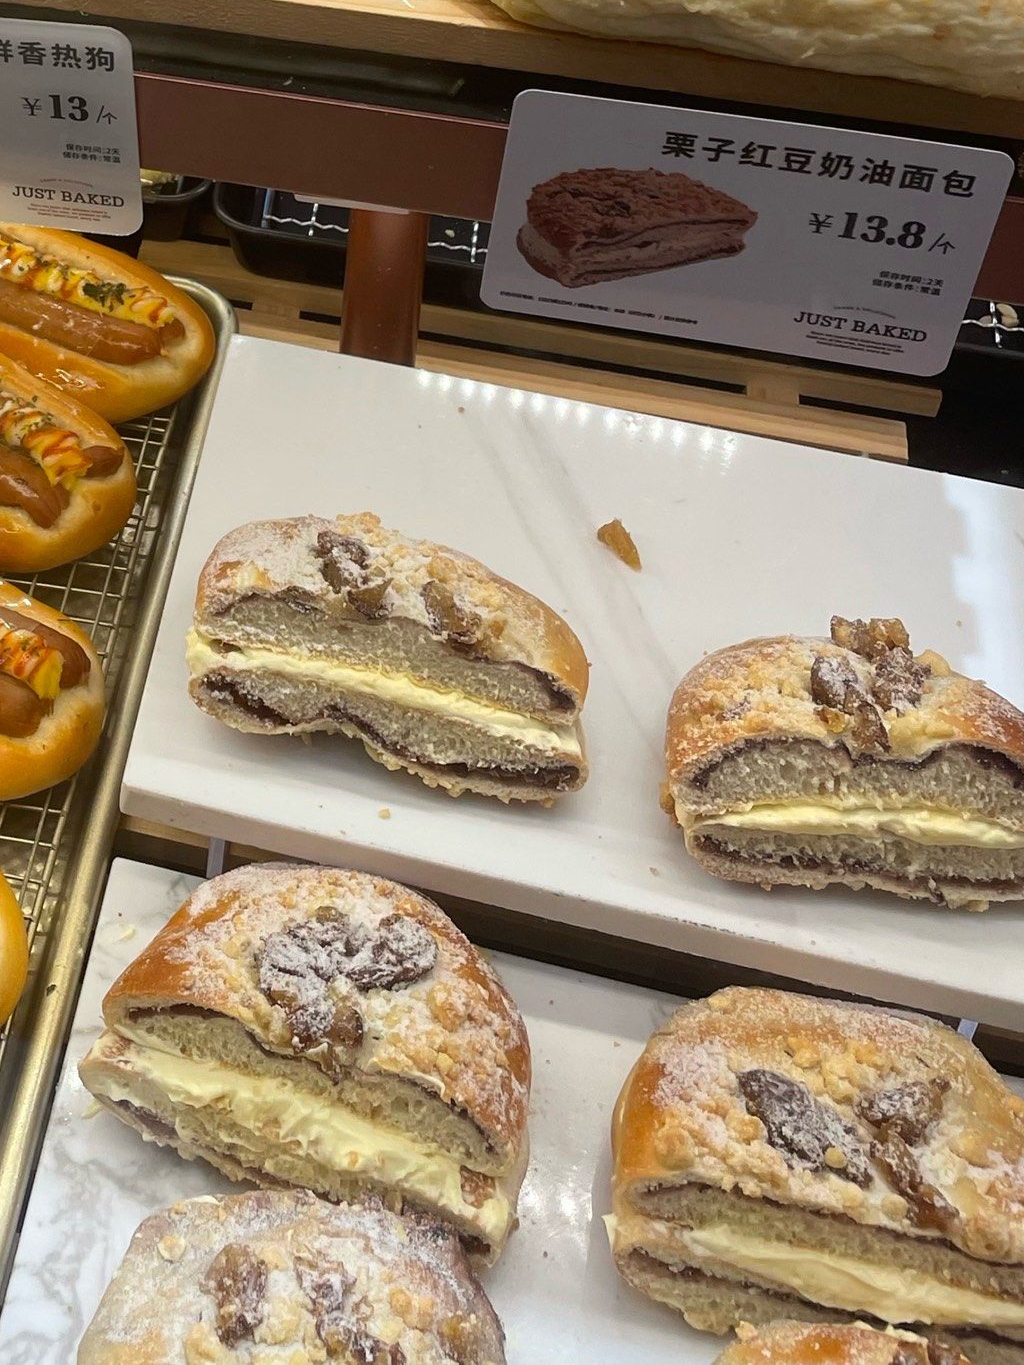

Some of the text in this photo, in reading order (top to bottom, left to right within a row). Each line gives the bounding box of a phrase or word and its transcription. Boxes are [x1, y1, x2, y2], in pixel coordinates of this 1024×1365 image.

[660, 129, 977, 200] 栗子红豆奶油面包
[11, 184, 125, 209] JUST BAKED
[793, 310, 849, 332] JUST
[852, 315, 928, 345] BAKED
